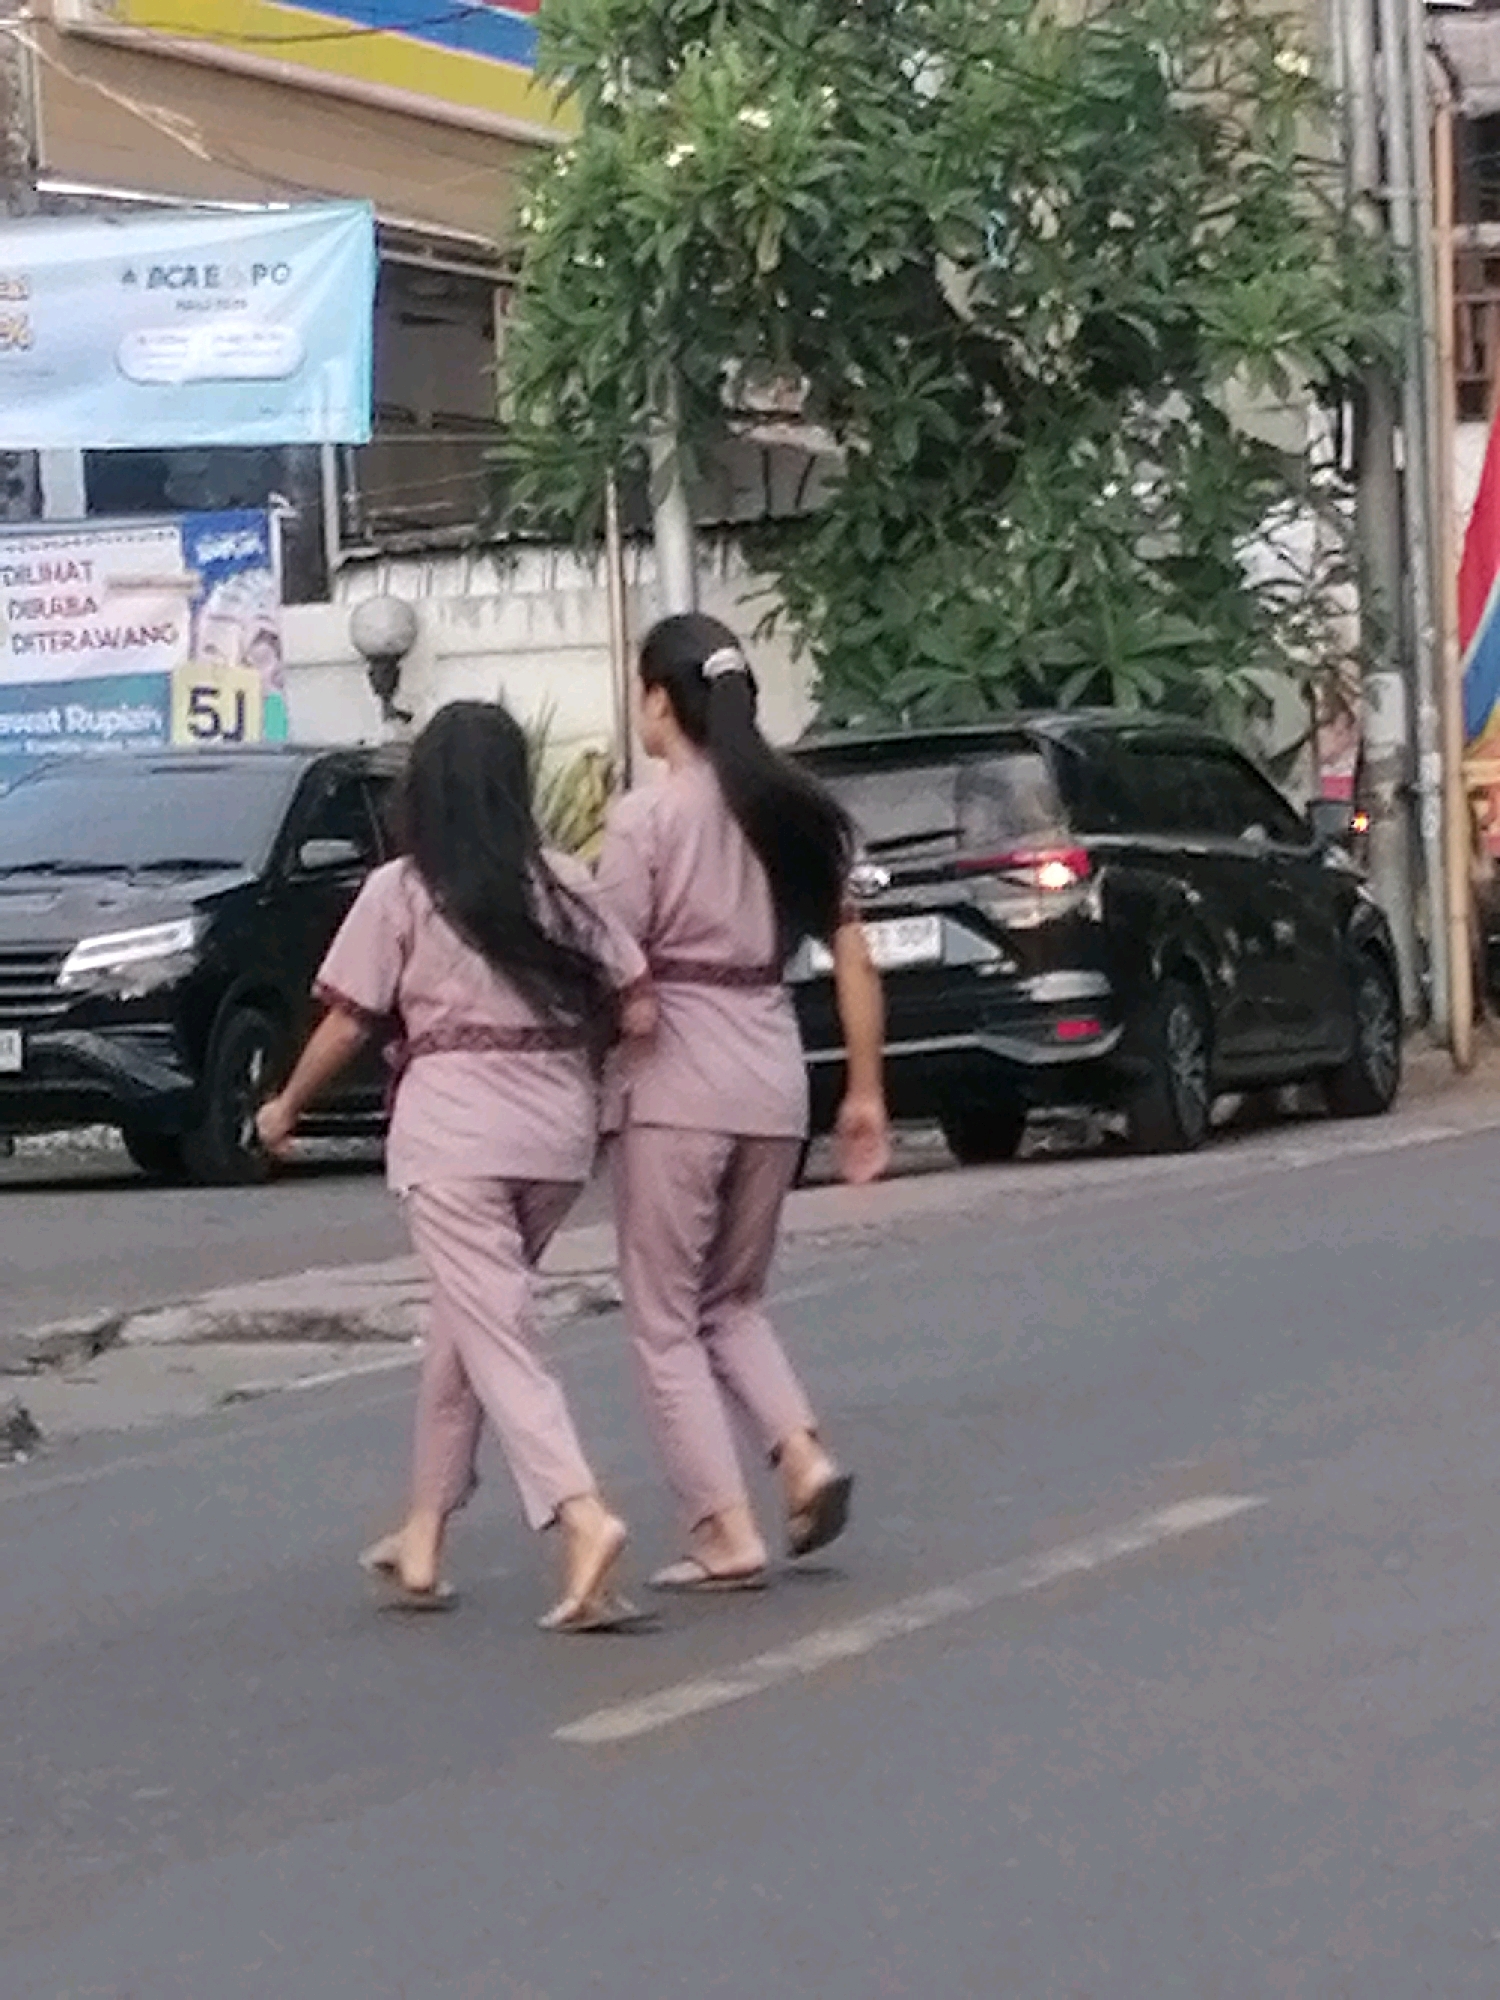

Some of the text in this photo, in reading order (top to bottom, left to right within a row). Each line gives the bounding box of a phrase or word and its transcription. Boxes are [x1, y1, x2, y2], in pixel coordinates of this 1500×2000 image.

[203, 262, 291, 289] EPO
[11, 622, 180, 655] DITERAWANG
[187, 686, 245, 741] 5J
